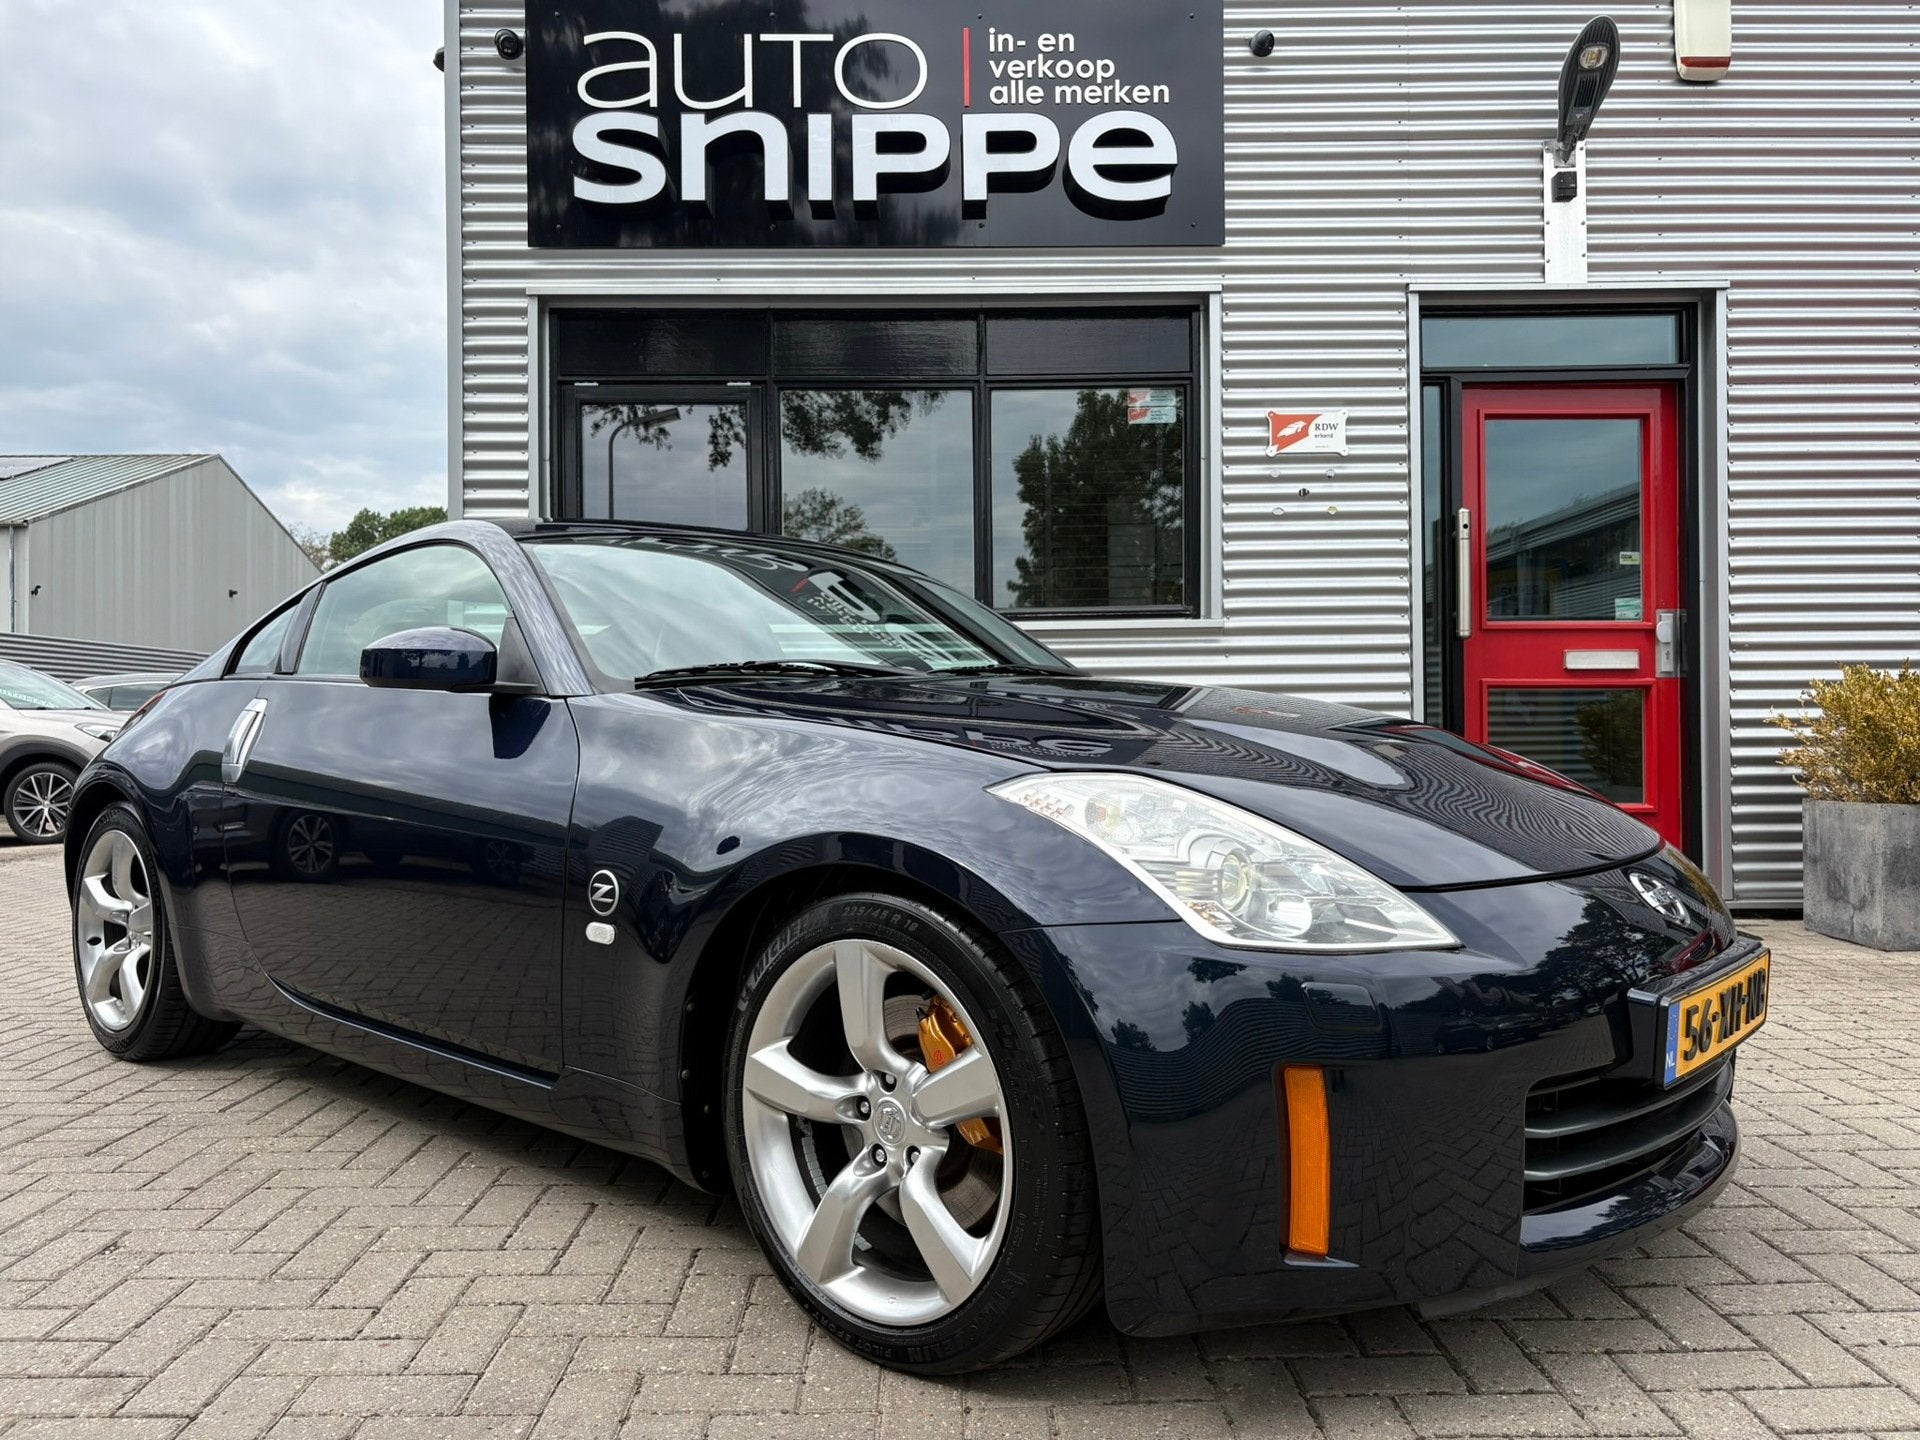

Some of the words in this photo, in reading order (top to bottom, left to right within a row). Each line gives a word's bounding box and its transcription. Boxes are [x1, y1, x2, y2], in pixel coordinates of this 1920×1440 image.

[988, 27, 1027, 54] in-
[1037, 32, 1075, 54] en
[988, 54, 1115, 82] verkoop
[988, 80, 1048, 105] alle
[1054, 80, 1170, 105] merken
[1314, 422, 1339, 431] RDW
[1666, 1053, 1676, 1069] NL
